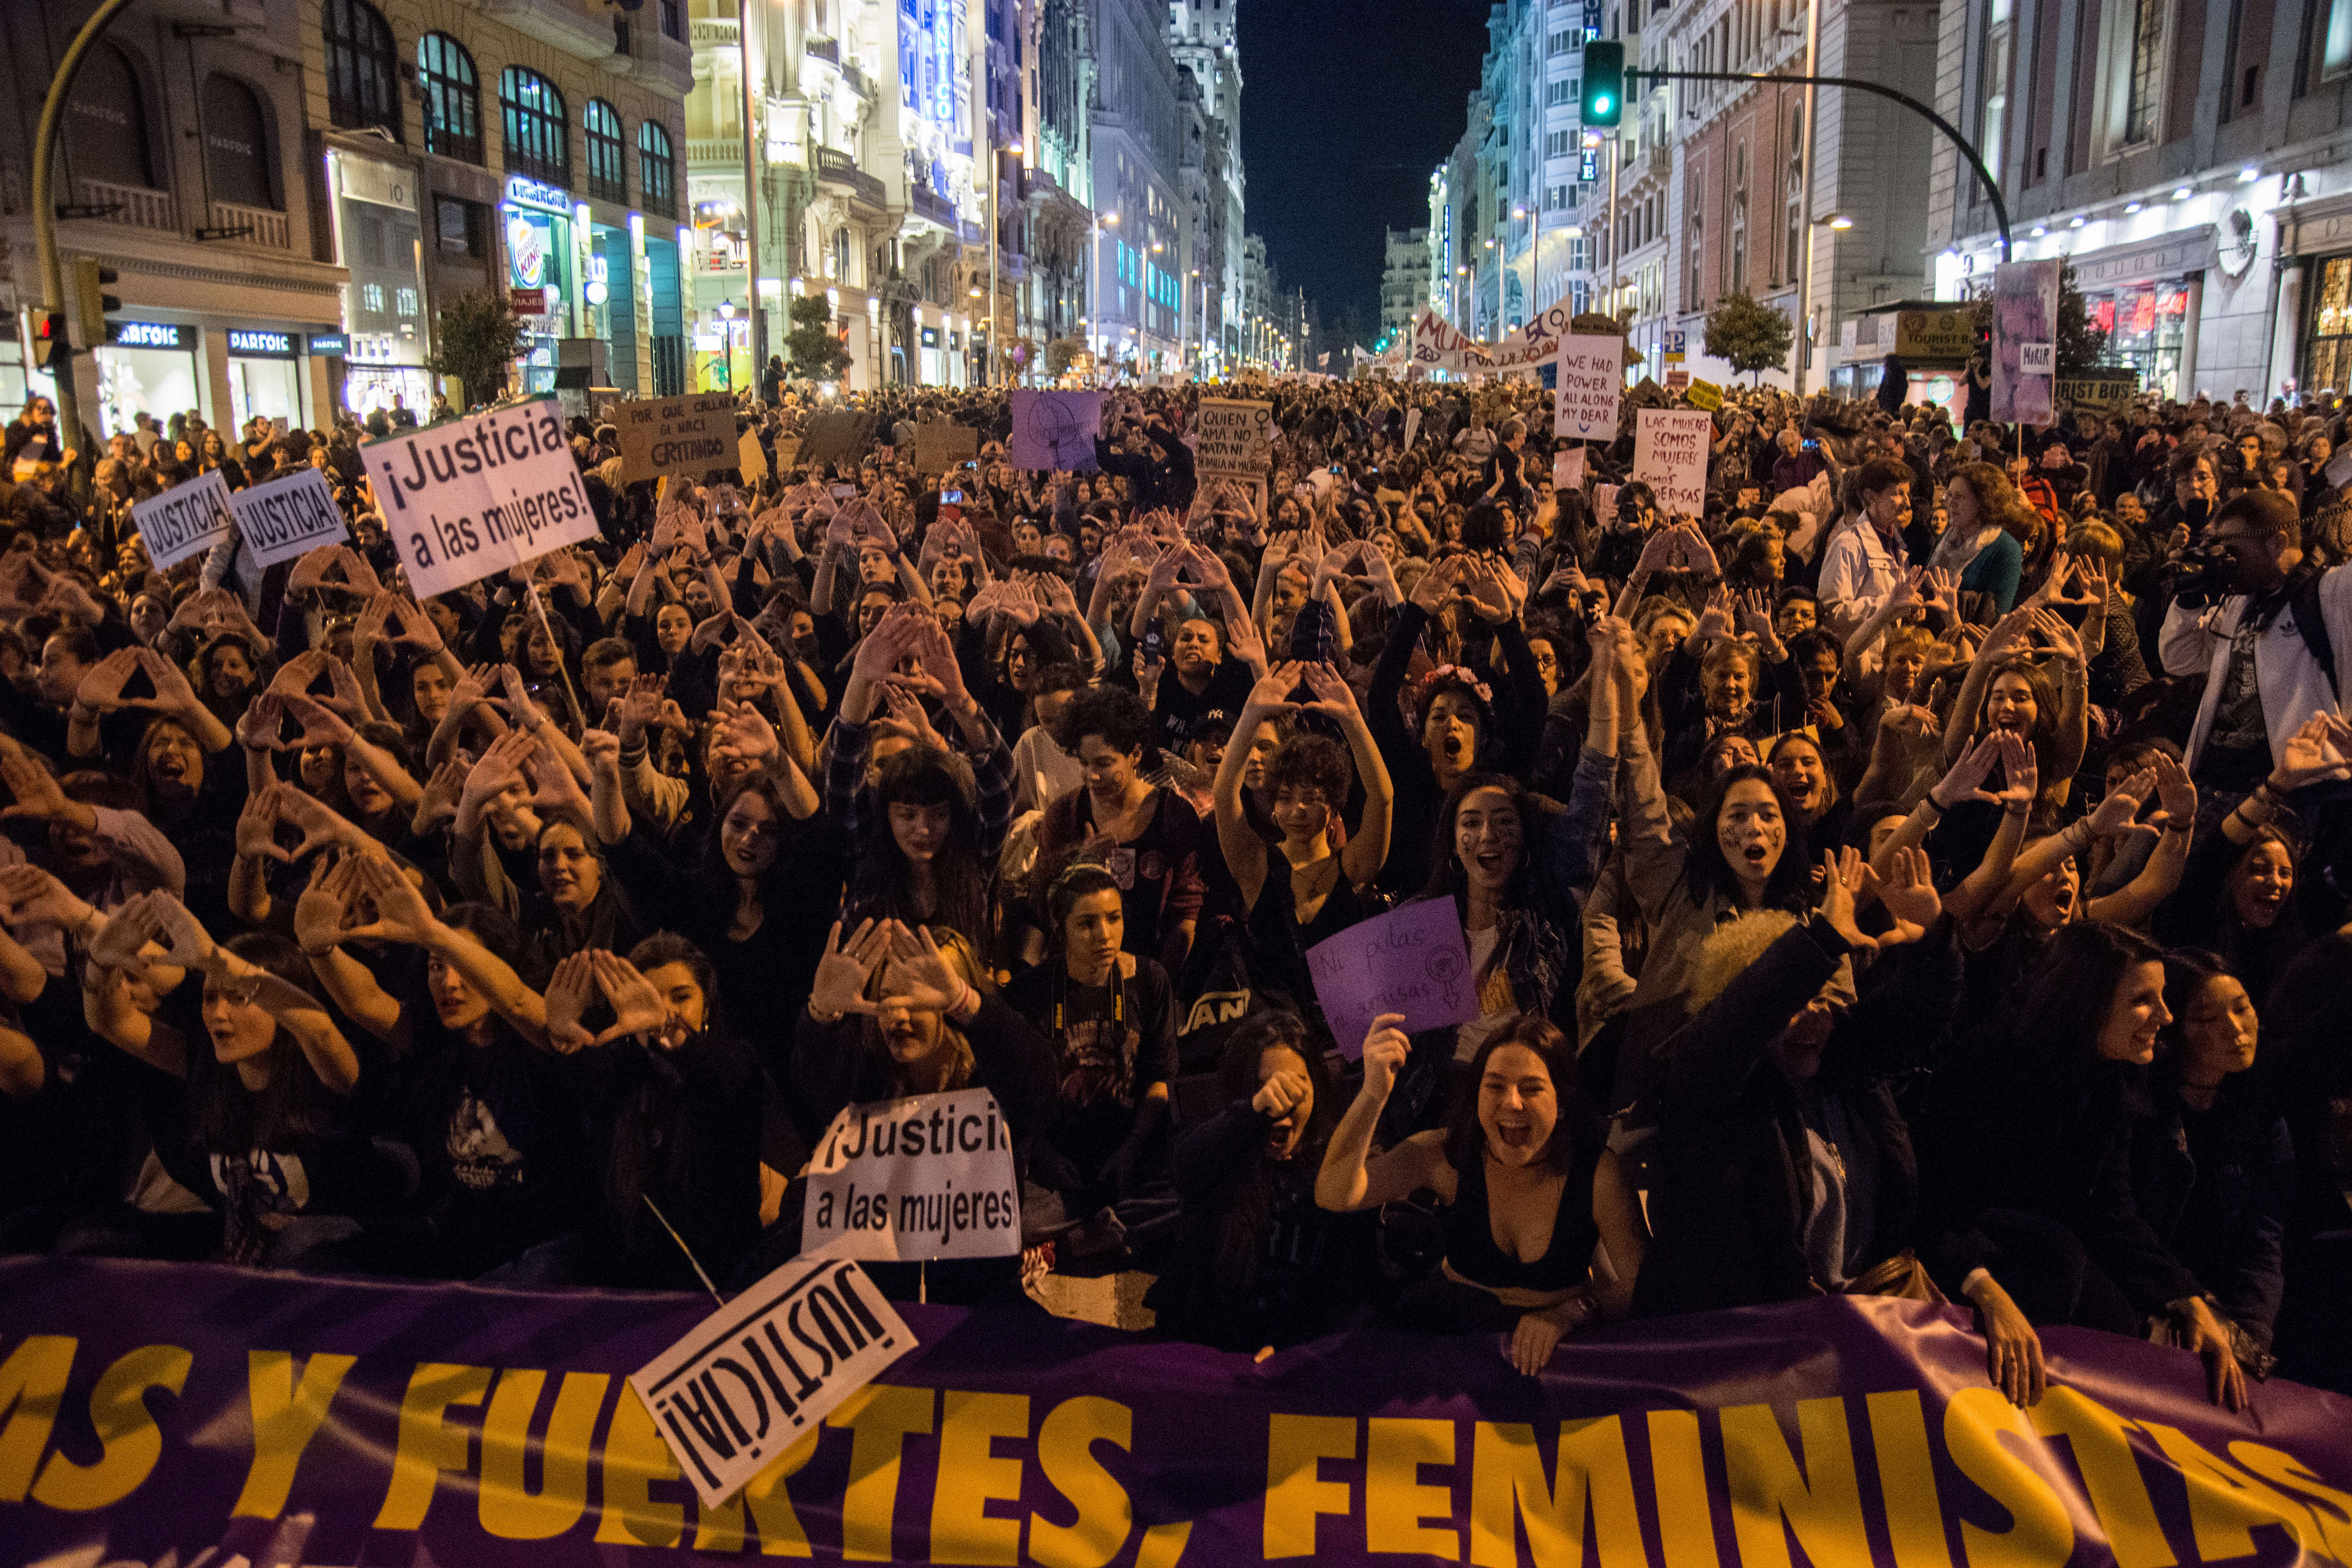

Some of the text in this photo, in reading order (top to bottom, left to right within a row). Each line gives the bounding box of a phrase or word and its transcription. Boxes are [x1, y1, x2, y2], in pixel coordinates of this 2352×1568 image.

[517, 233, 537, 260] BURGER
[521, 244, 540, 276] KING
[230, 332, 290, 351] PARFOIS
[313, 340, 342, 349] PARFOIS
[1908, 334, 1956, 343] TOURIST
[1567, 354, 1613, 373] WE HAD
[1567, 373, 1607, 391] POWER
[2098, 382, 2129, 399] BUS
[1564, 391, 1613, 407] ALL ALONG
[1203, 410, 1247, 426] QUIEN
[1562, 407, 1609, 423] MY DEAR
[1645, 416, 1709, 432] LAS MUJERES
[1201, 427, 1251, 442] AMA NO
[1653, 431, 1696, 449] SOMOS
[1199, 442, 1228, 455] MATA
[381, 408, 564, 510] ¡Justicia
[1654, 486, 1701, 504] DEROSAS
[237, 482, 339, 549] ¡JUSTICIA!
[410, 471, 588, 569] a las mujeres!
[816, 1190, 834, 1229] a
[844, 1183, 889, 1232] las
[230, 1349, 358, 1520] Y
